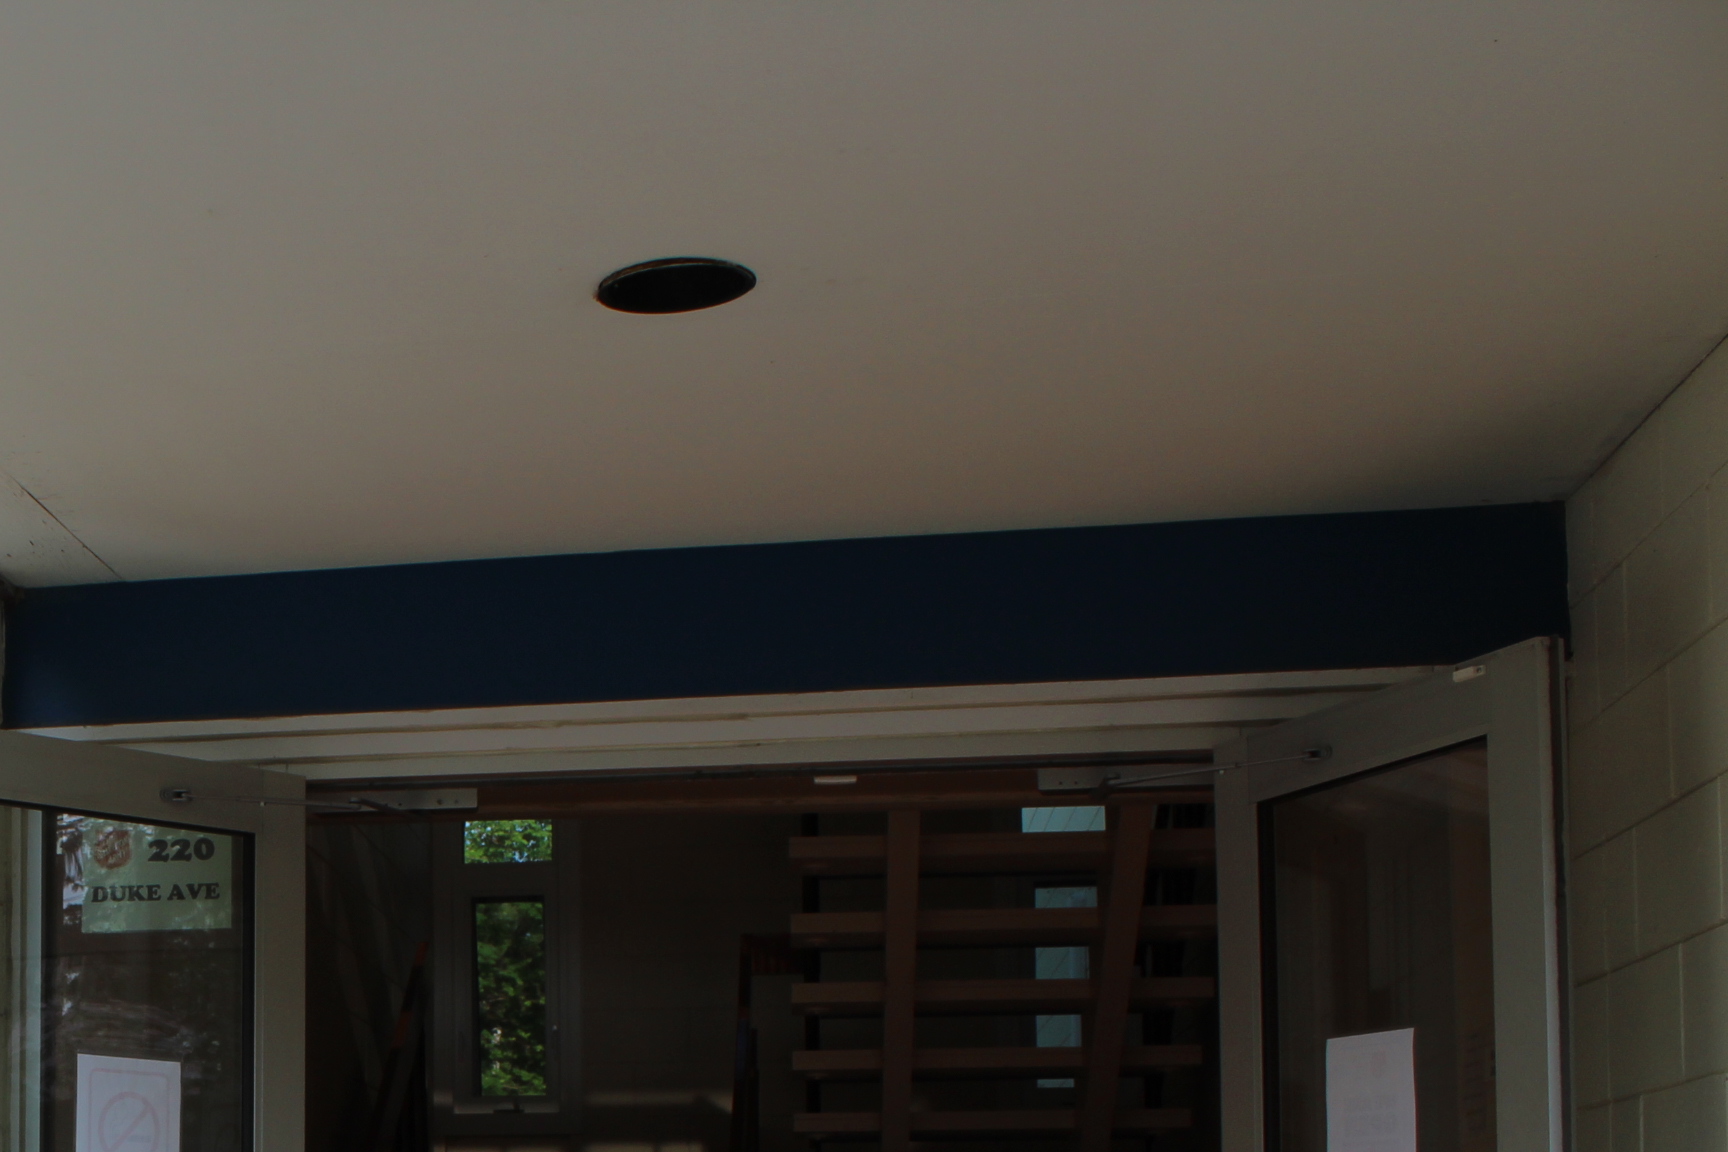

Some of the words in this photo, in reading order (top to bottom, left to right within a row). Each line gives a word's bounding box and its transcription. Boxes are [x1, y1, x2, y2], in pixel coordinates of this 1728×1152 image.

[147, 837, 215, 863] 220
[91, 883, 162, 903] DUKE
[167, 882, 221, 901] AVE
